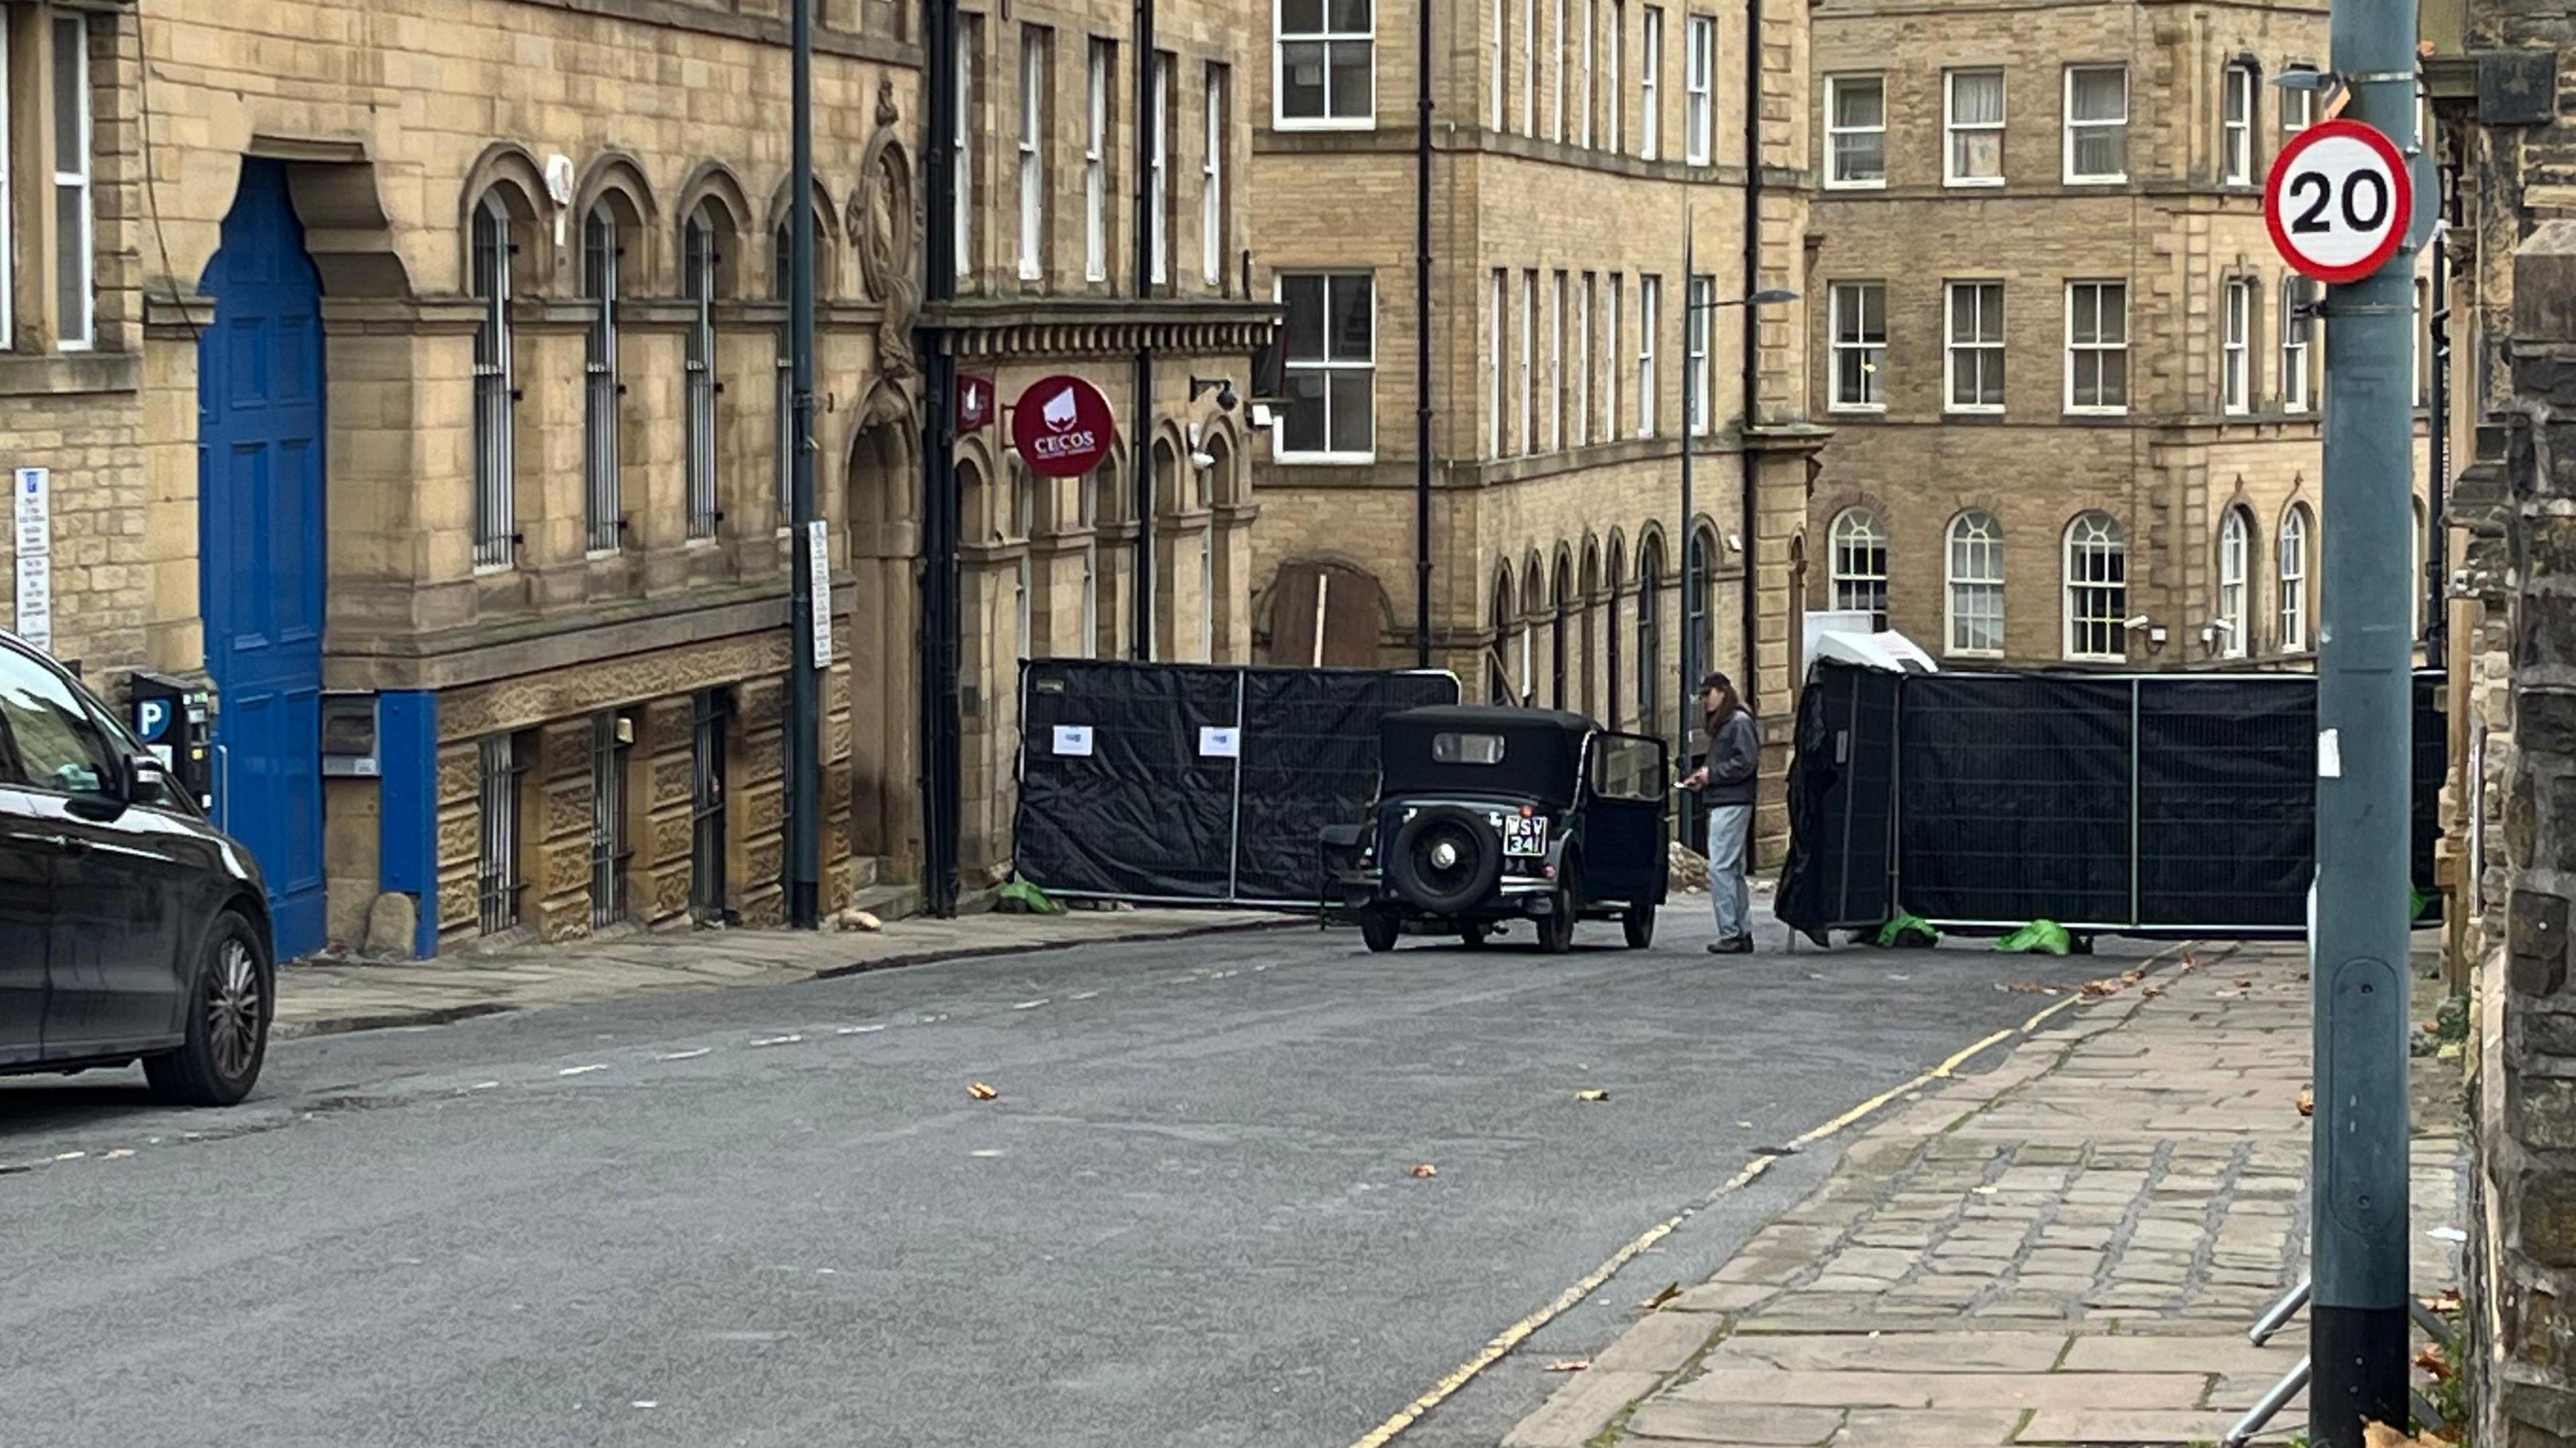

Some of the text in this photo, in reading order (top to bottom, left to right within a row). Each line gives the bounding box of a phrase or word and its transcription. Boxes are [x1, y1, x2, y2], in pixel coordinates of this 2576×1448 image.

[2290, 168, 2388, 234] 20
[1034, 430, 1095, 453] CECOS
[141, 702, 162, 735] P
